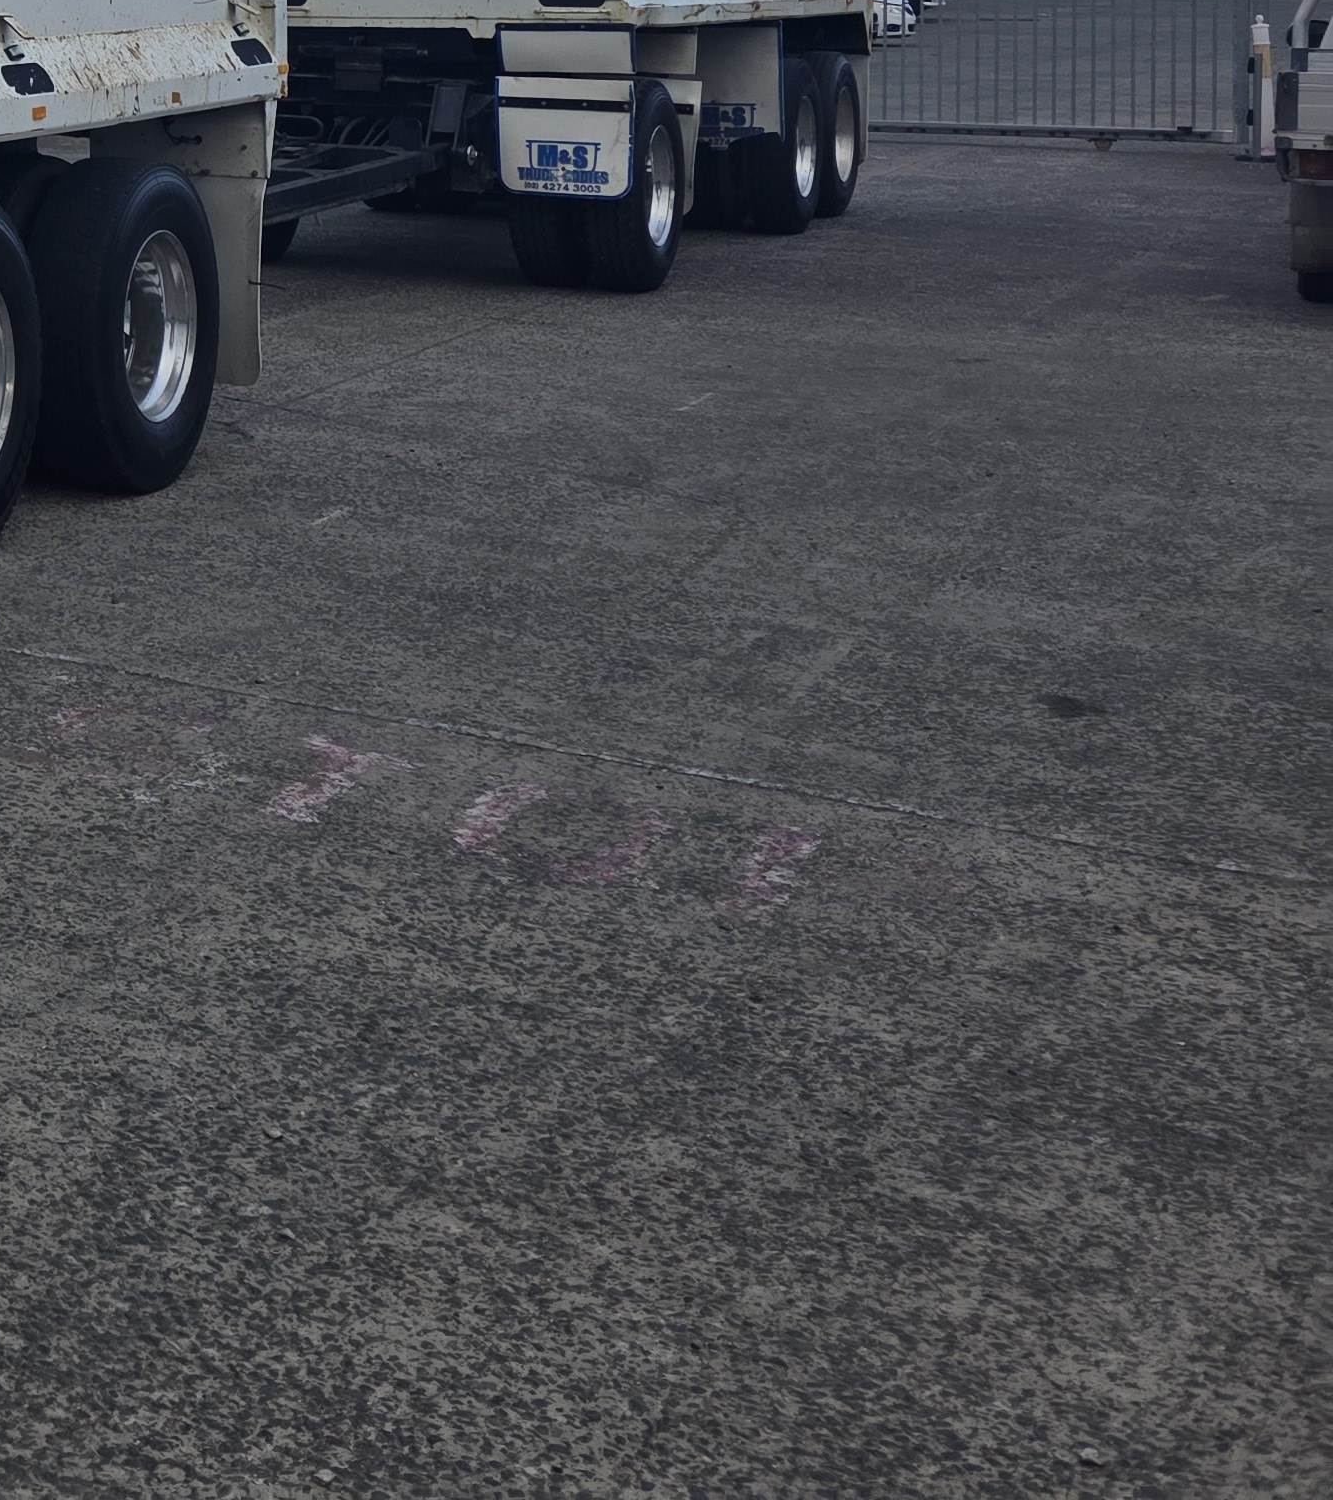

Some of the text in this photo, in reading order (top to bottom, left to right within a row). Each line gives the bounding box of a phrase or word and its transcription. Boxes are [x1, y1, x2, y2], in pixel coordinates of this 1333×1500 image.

[537, 145, 588, 168] M&S
[542, 183, 570, 192] 4274
[573, 184, 601, 193] 3003
